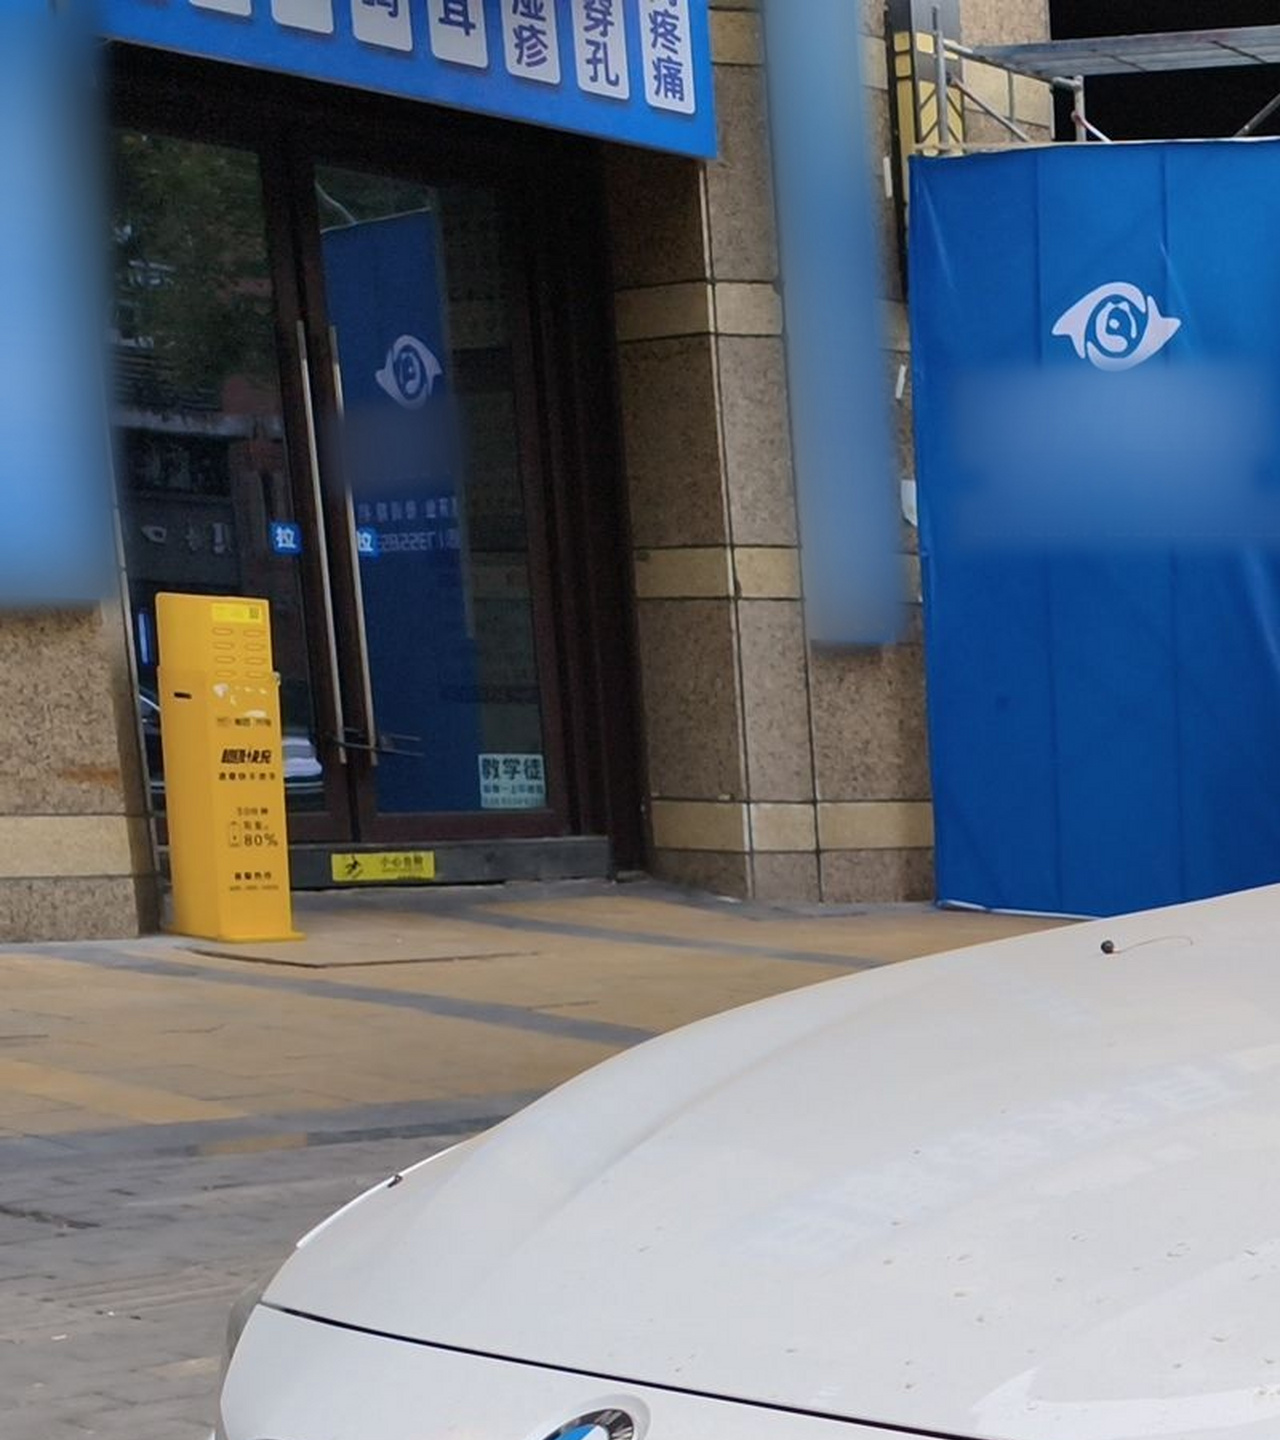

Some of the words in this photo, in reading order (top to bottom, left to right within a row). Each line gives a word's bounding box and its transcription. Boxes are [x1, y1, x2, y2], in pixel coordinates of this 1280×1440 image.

[648, 0, 685, 102] 疼痛
[276, 526, 296, 548] 拉
[243, 833, 279, 847] 80%
